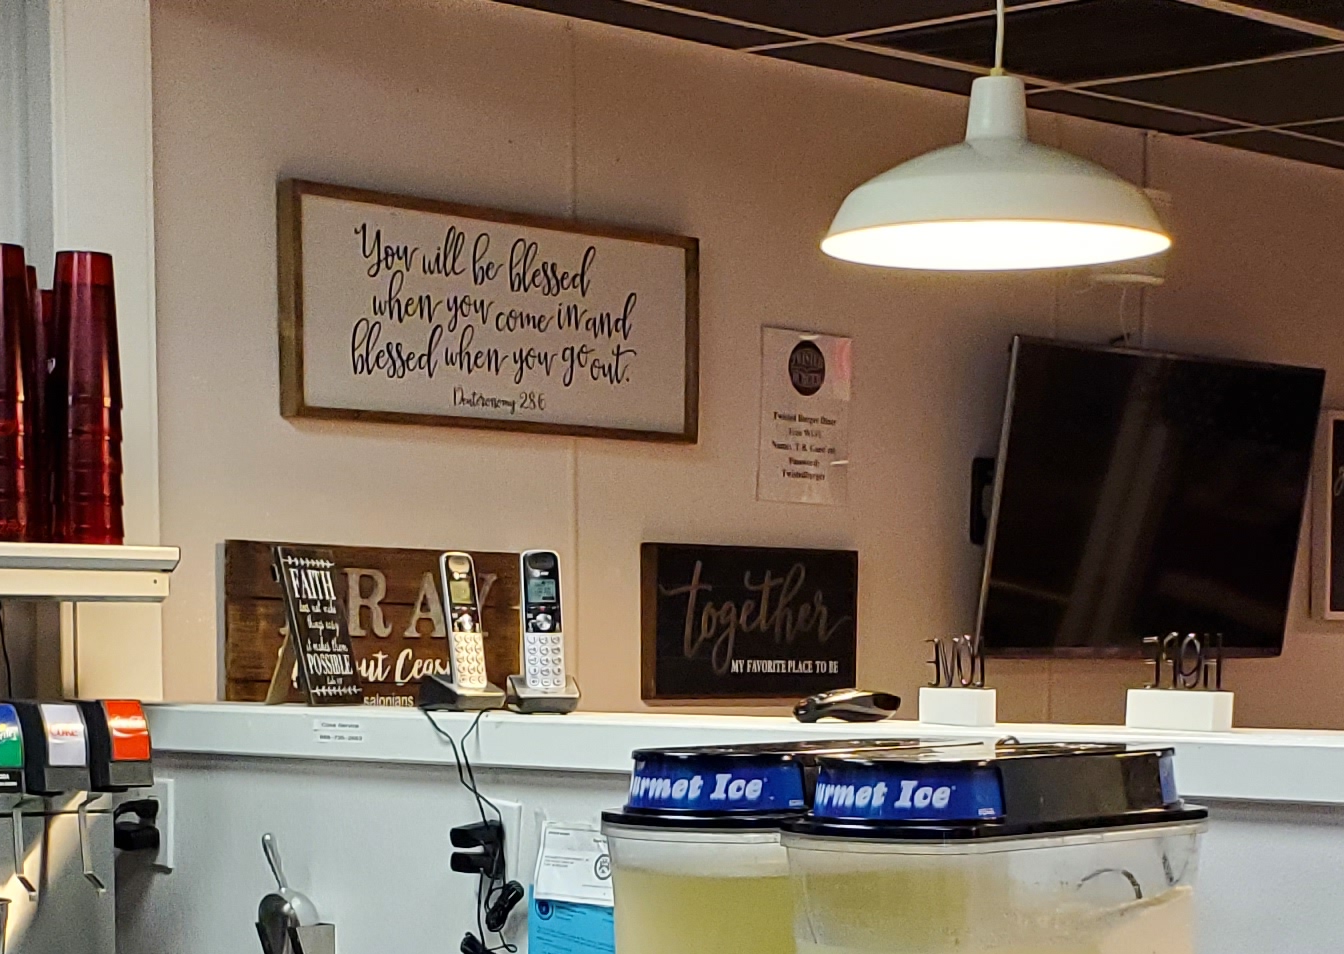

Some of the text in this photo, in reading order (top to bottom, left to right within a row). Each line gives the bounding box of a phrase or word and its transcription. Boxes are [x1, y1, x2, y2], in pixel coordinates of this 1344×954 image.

[354, 223, 596, 298] You will be blessed
[372, 270, 637, 341] when you come in and
[351, 318, 444, 379] blessed
[444, 324, 509, 376] when
[511, 347, 559, 385] you
[561, 344, 595, 387] go
[289, 567, 337, 601] FAITH
[659, 559, 853, 677] together
[307, 653, 354, 676] POSSIBLE
[730, 659, 839, 674] MY FAVORITE PLACE TO BE
[630, 773, 764, 801] urmet Ice
[814, 780, 952, 809] urmet Ice
